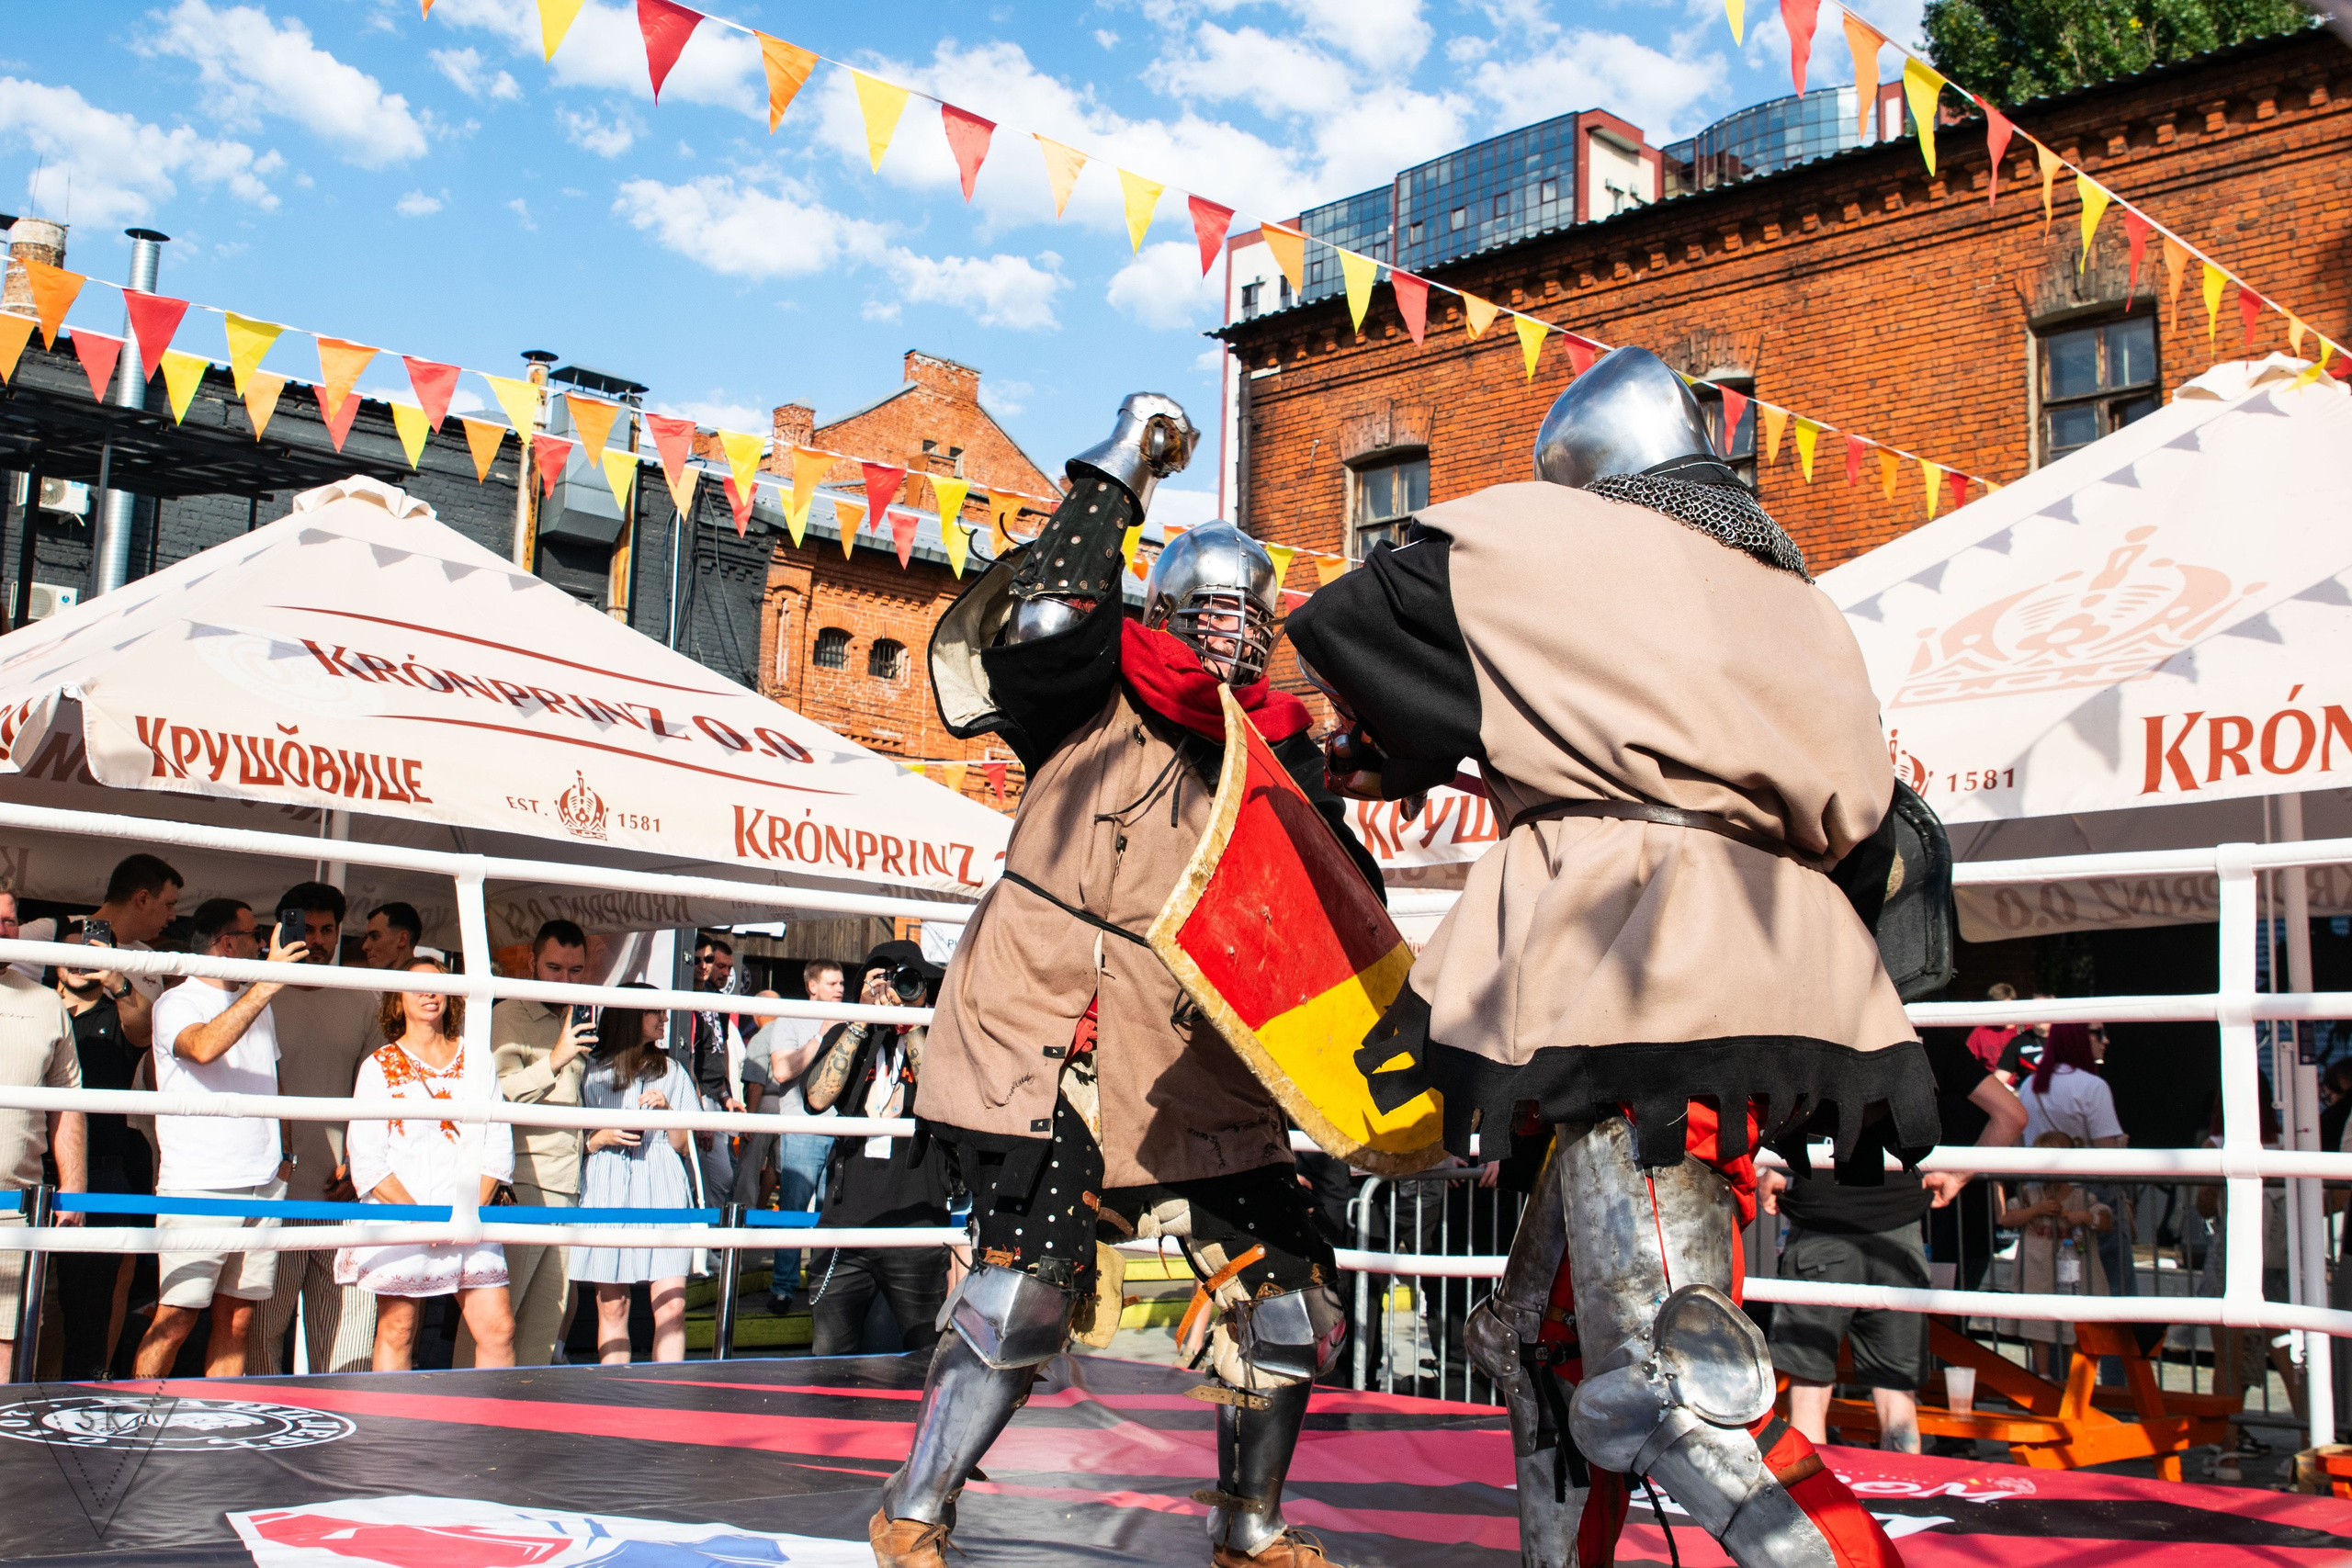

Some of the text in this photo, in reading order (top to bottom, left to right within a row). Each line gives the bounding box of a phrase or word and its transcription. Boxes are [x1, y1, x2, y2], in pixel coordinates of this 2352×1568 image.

[298, 637, 691, 742] KRÓNPRINZ
[1946, 766, 2015, 795] 1581
[505, 795, 662, 834] EST. 1581
[731, 804, 987, 892] KRÓNPRINZ
